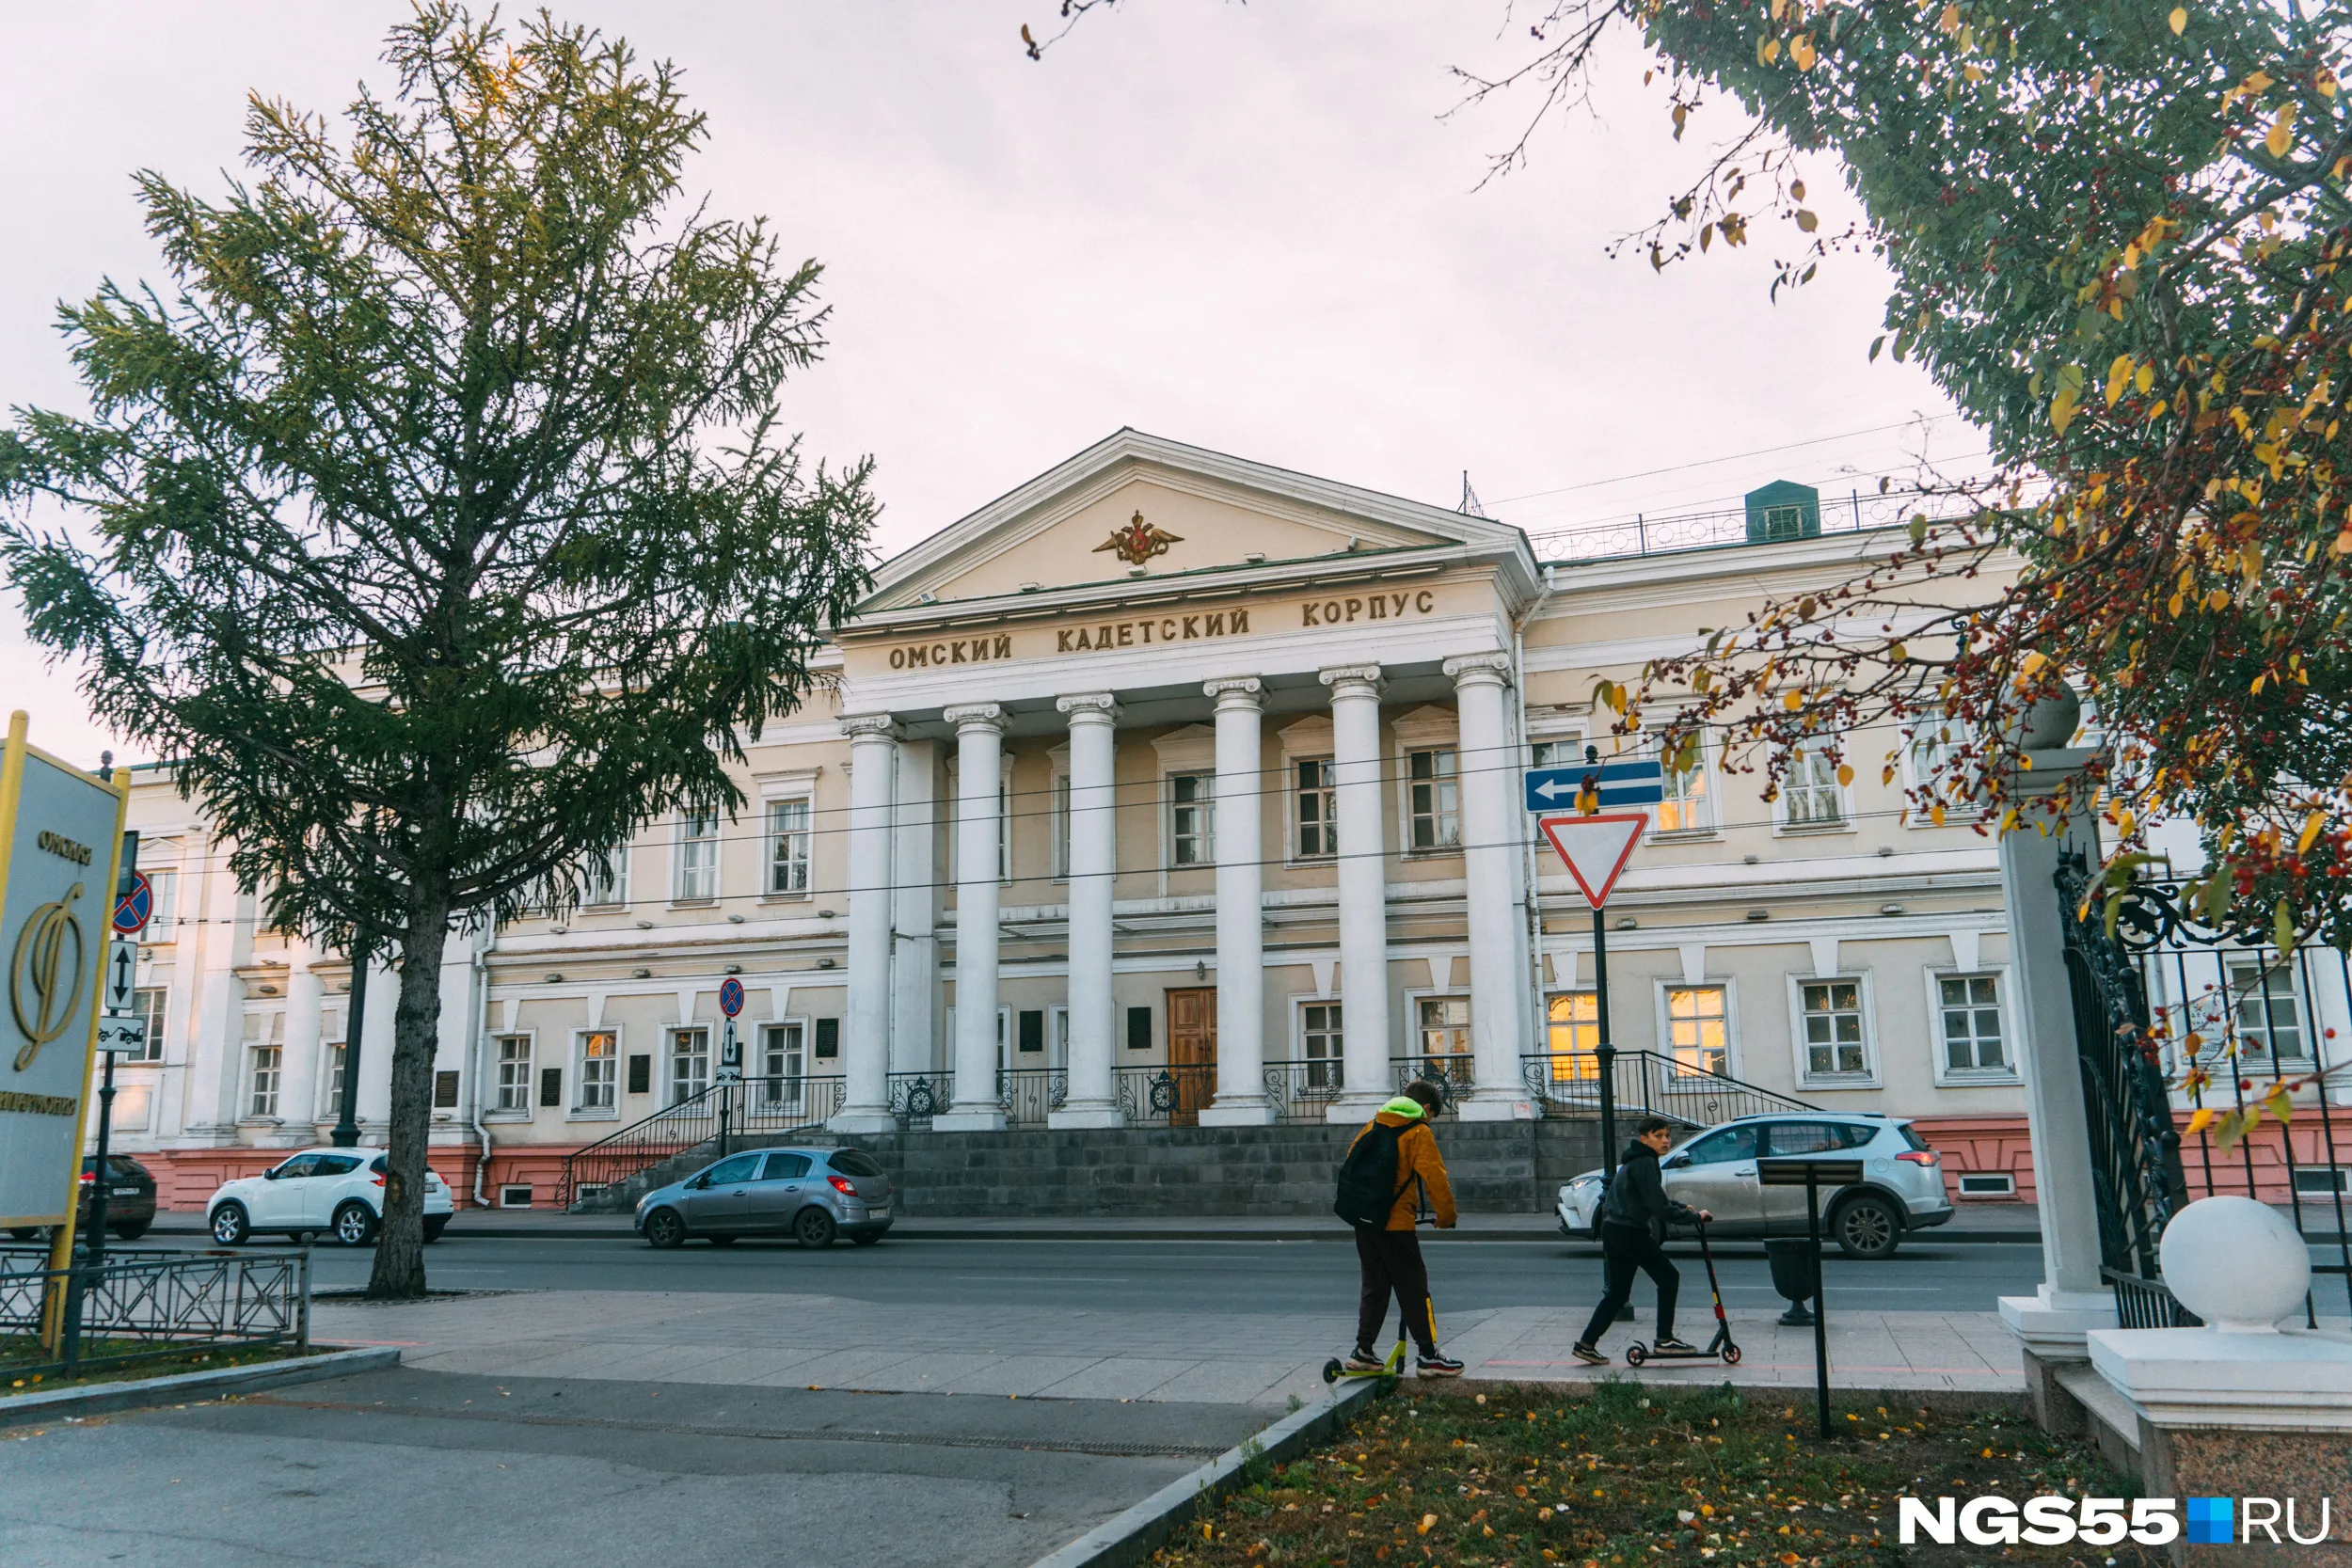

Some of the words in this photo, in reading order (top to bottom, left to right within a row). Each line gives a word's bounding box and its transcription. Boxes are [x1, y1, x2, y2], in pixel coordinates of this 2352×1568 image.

[889, 633, 1011, 669] ОМСКИЙ
[1057, 609, 1249, 652] КАДЕТСКИЙ
[1302, 591, 1434, 626] КОРПУС
[38, 830, 91, 865] ОМСКАЯ
